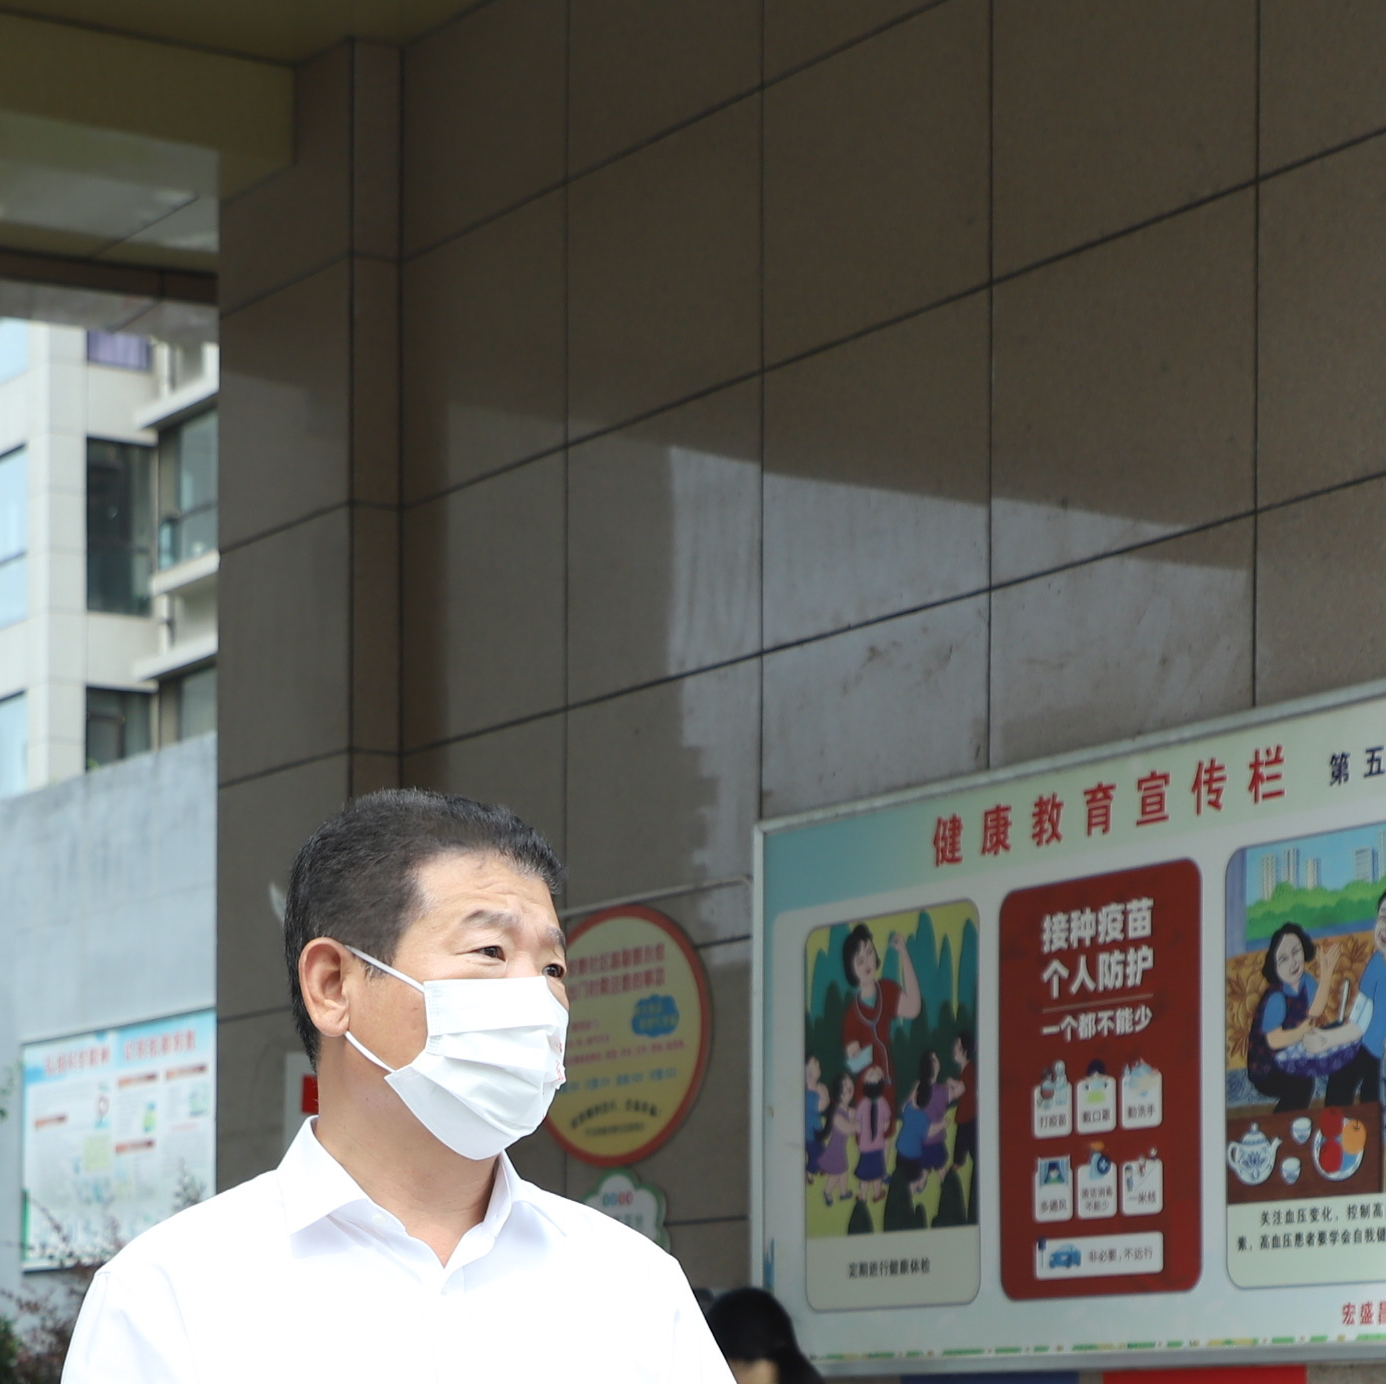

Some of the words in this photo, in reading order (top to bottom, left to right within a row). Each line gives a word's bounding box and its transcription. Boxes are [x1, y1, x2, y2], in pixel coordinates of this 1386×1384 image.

[932, 745, 1286, 868] 健康教育宣传栏
[1042, 897, 1155, 954] 接种疫苗
[1041, 945, 1155, 999] 个人防护
[1041, 1005, 1154, 1042] 一个都不能少
[1039, 1115, 1067, 1129] 打疫苗
[1082, 1109, 1111, 1124] 戴口罩
[848, 1257, 931, 1279] 定期进行健康体检
